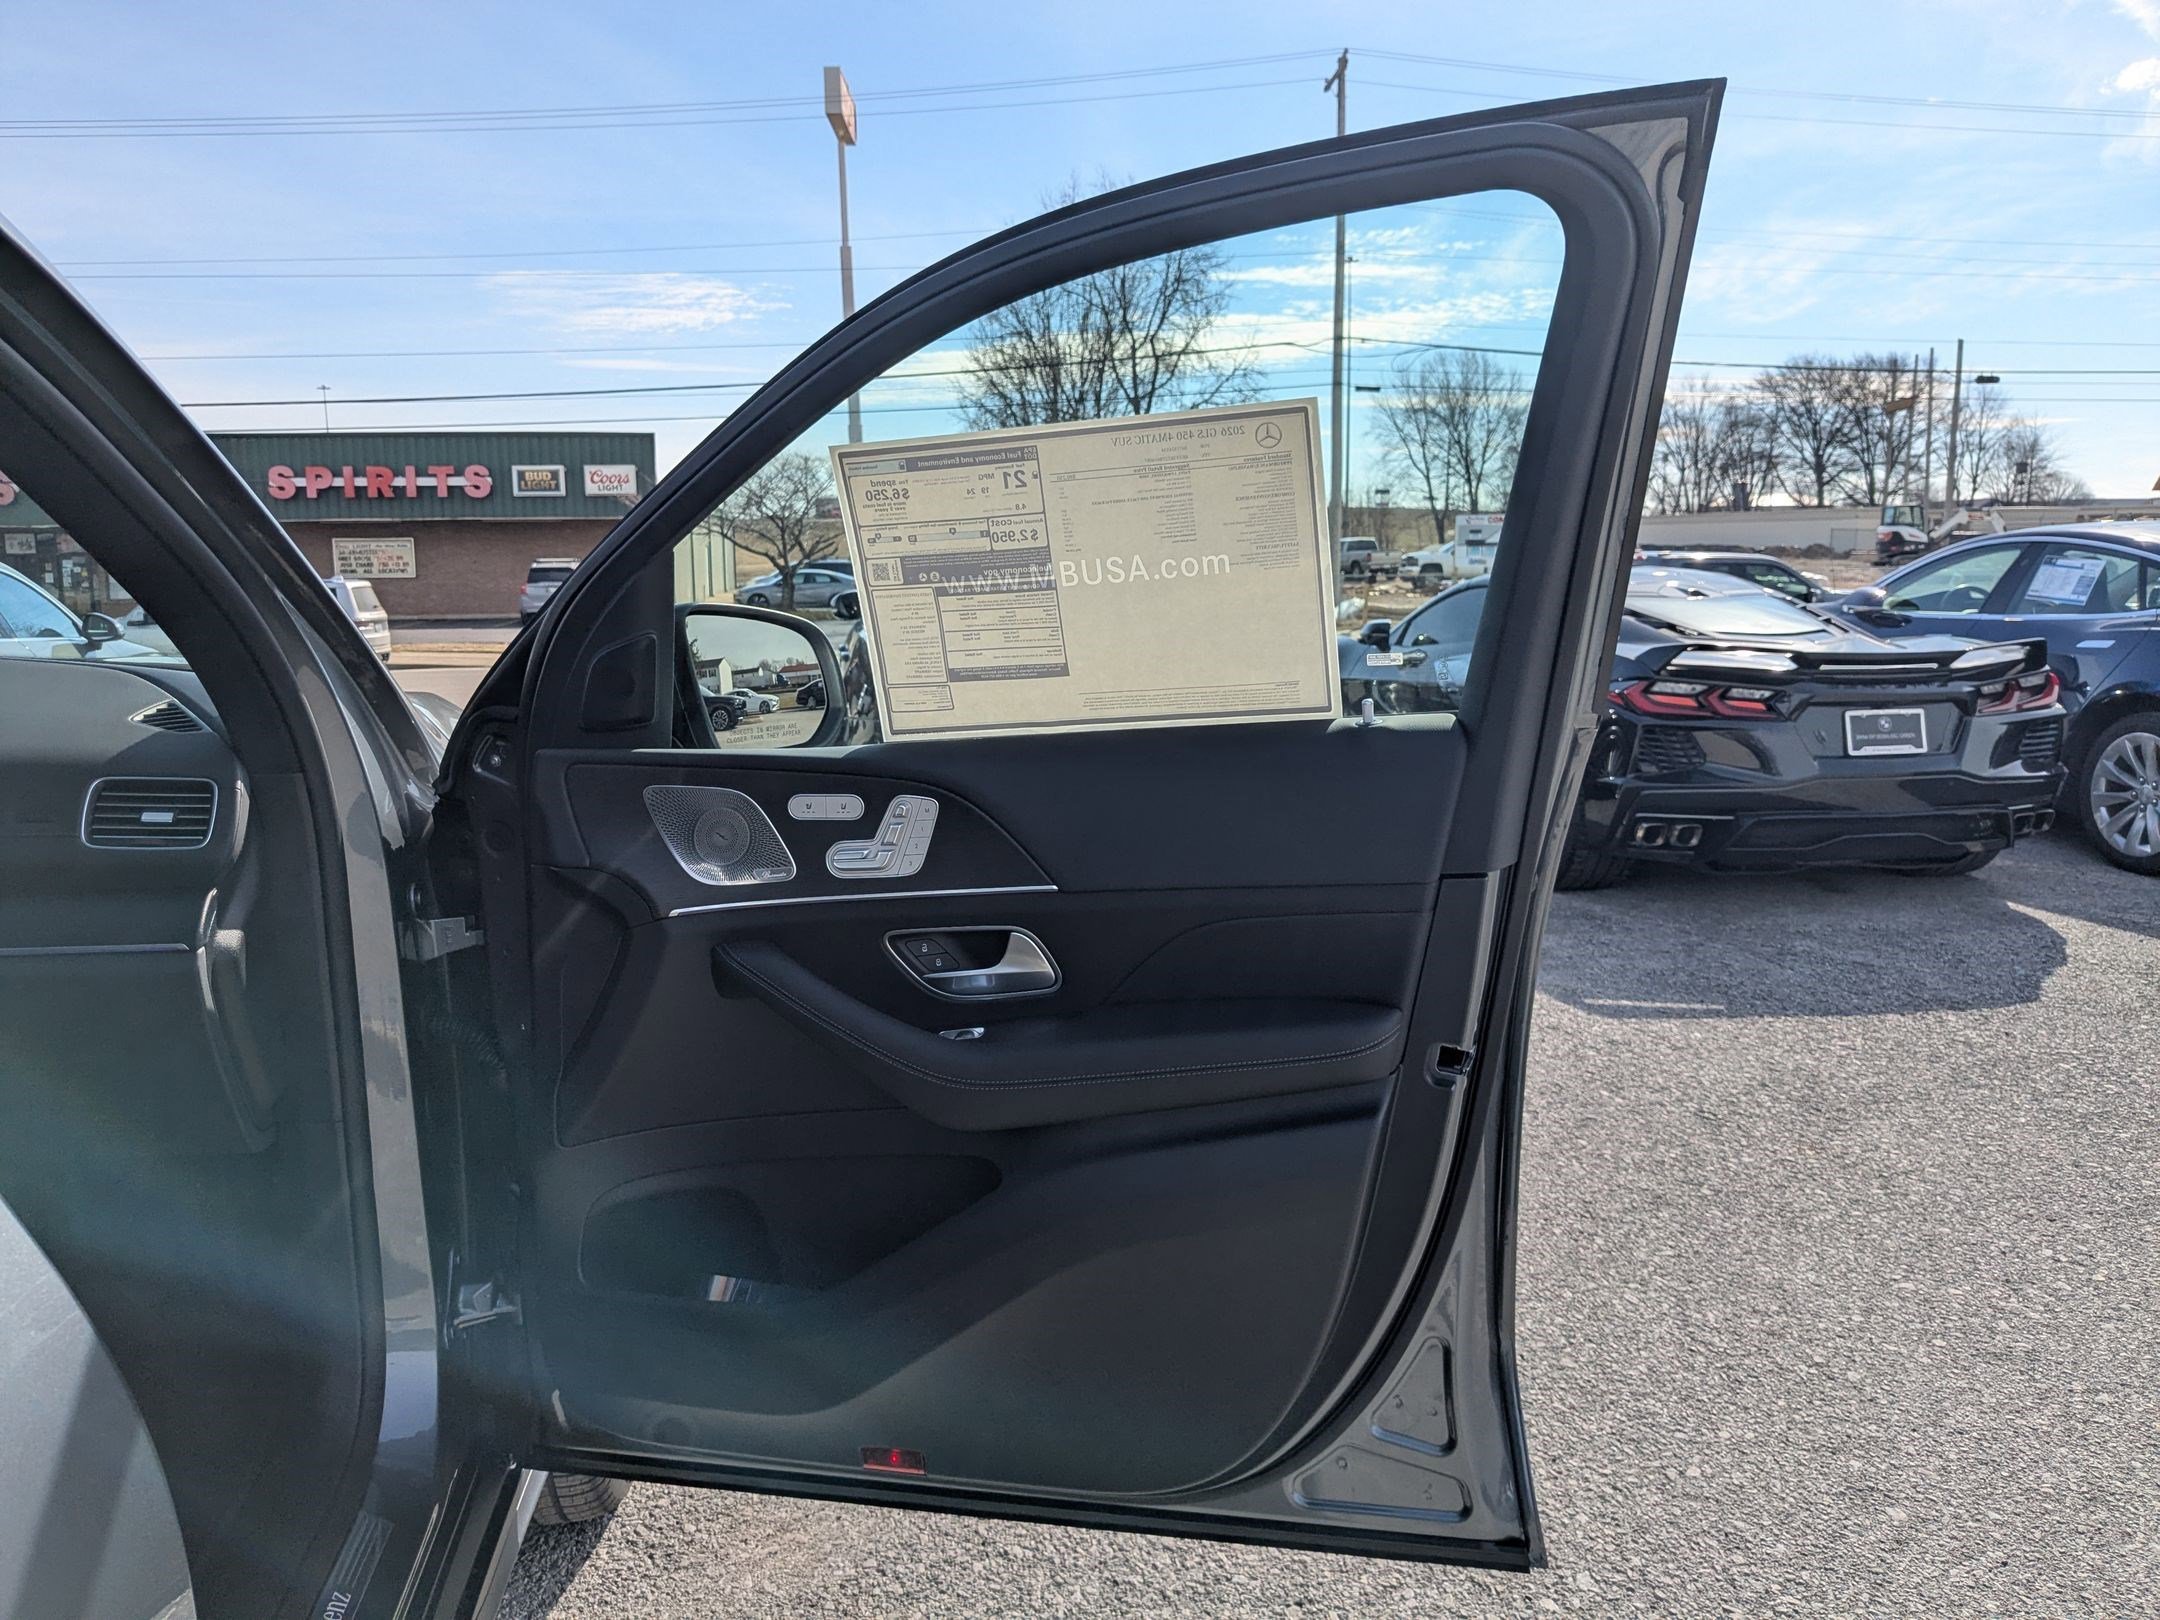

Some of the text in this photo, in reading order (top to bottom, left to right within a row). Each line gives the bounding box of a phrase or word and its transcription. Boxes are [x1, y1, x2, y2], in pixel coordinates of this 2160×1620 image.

[267, 464, 492, 500] SPIRITS
[525, 472, 552, 481] BUD
[589, 470, 630, 484] Coors
[521, 481, 557, 490] LIGHT
